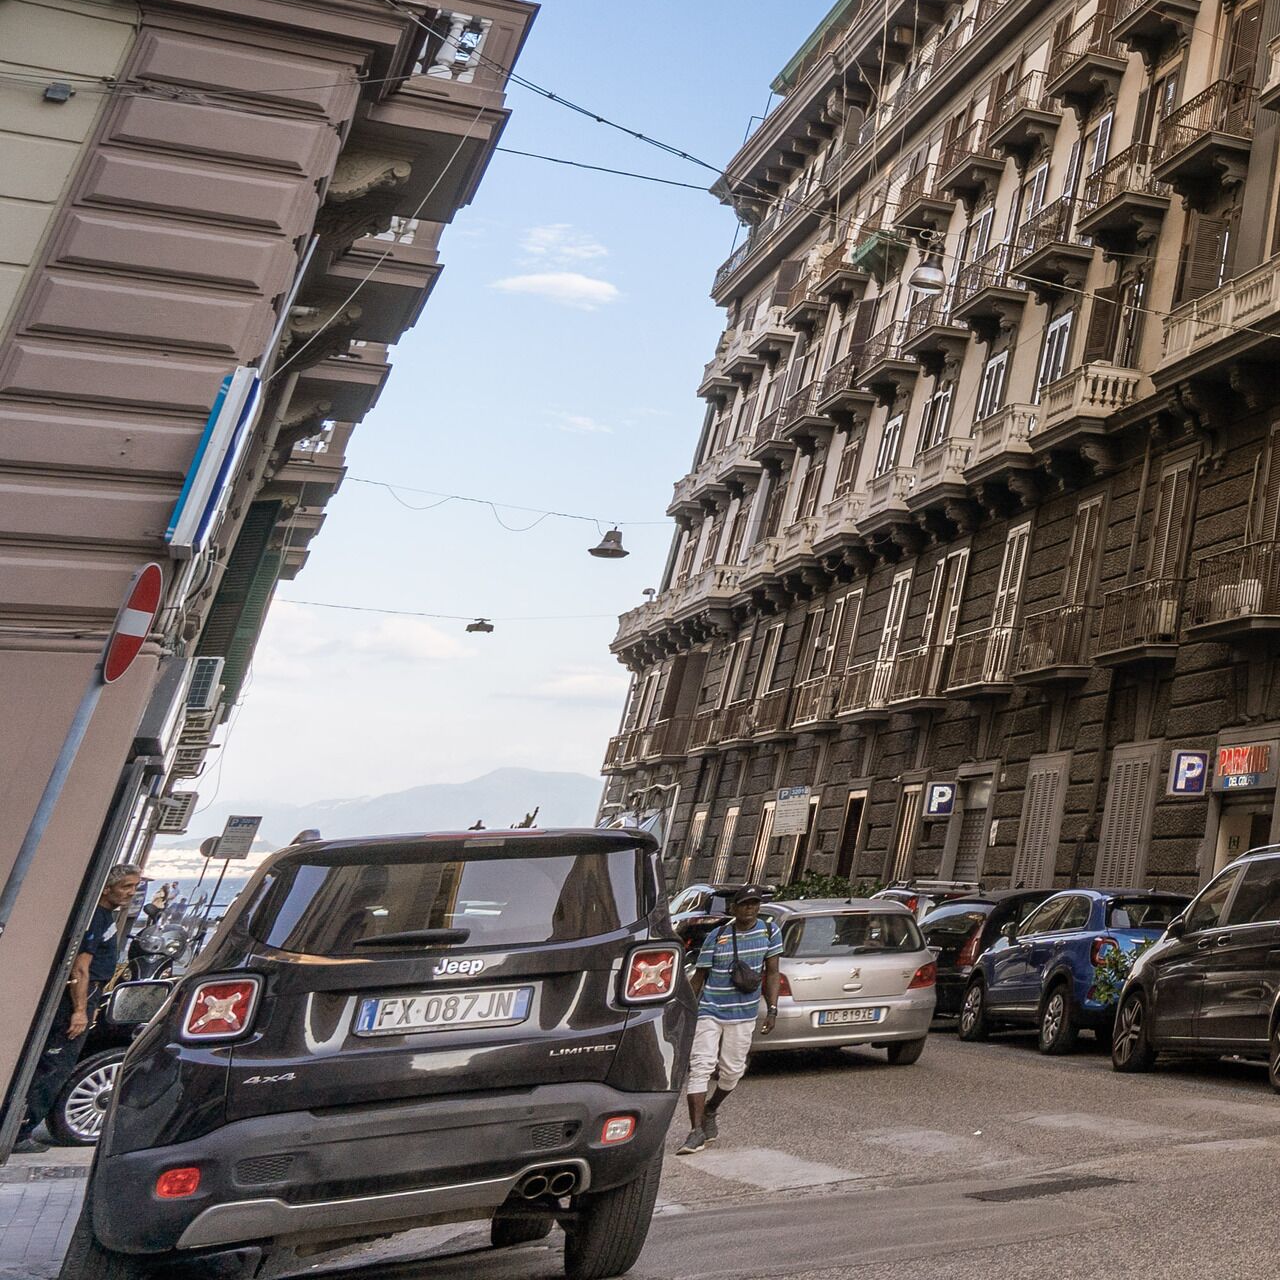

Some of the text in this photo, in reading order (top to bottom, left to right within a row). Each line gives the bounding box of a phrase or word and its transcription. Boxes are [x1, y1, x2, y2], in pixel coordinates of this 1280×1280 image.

[1176, 755, 1203, 789] P
[1218, 746, 1270, 776] PARKING
[1228, 776, 1238, 787] DEL
[930, 786, 952, 812] P
[433, 958, 484, 976] Jeep
[377, 999, 417, 1027] FX
[424, 991, 514, 1023] 087JN
[549, 1043, 617, 1057] LIMITED
[242, 1072, 297, 1085] 4x4
